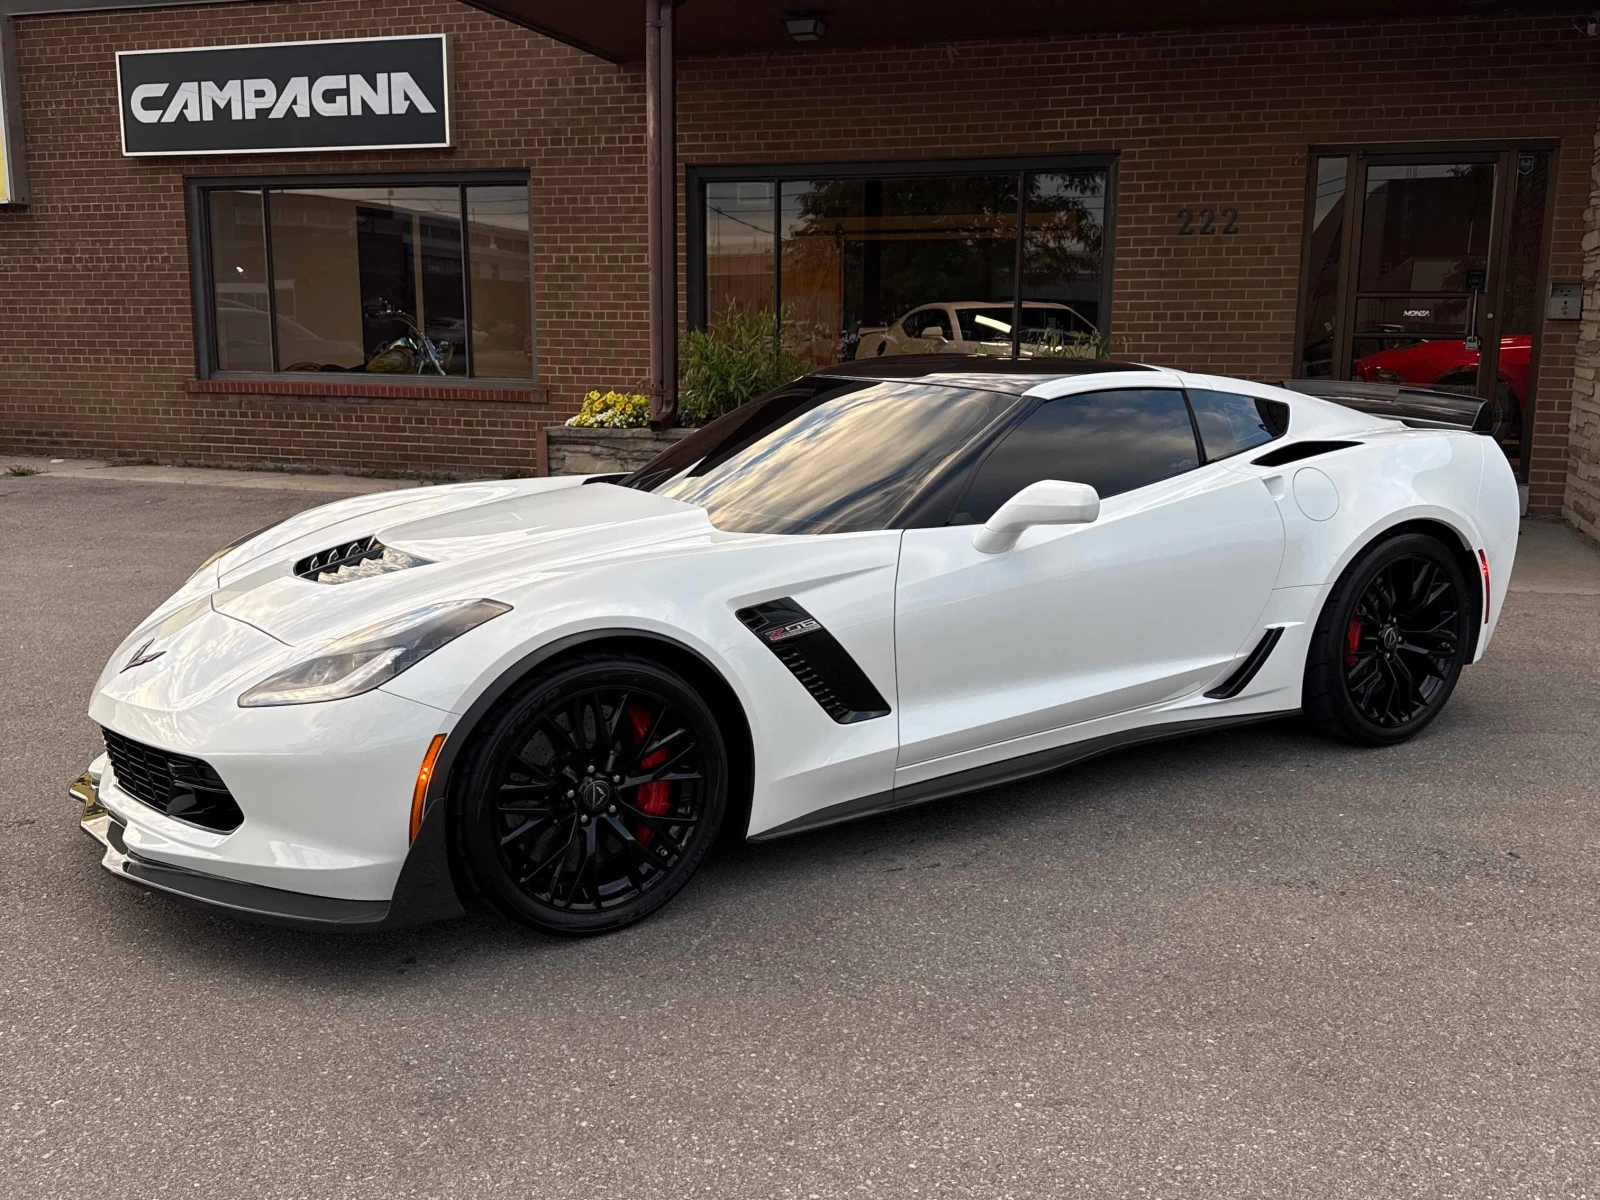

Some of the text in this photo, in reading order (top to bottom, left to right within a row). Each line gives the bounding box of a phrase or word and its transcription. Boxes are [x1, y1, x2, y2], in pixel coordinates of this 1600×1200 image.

[130, 71, 437, 124] CAMPAGNA
[1177, 207, 1239, 236] 222
[1402, 309, 1430, 317] MONZA
[764, 618, 820, 641] Z06
